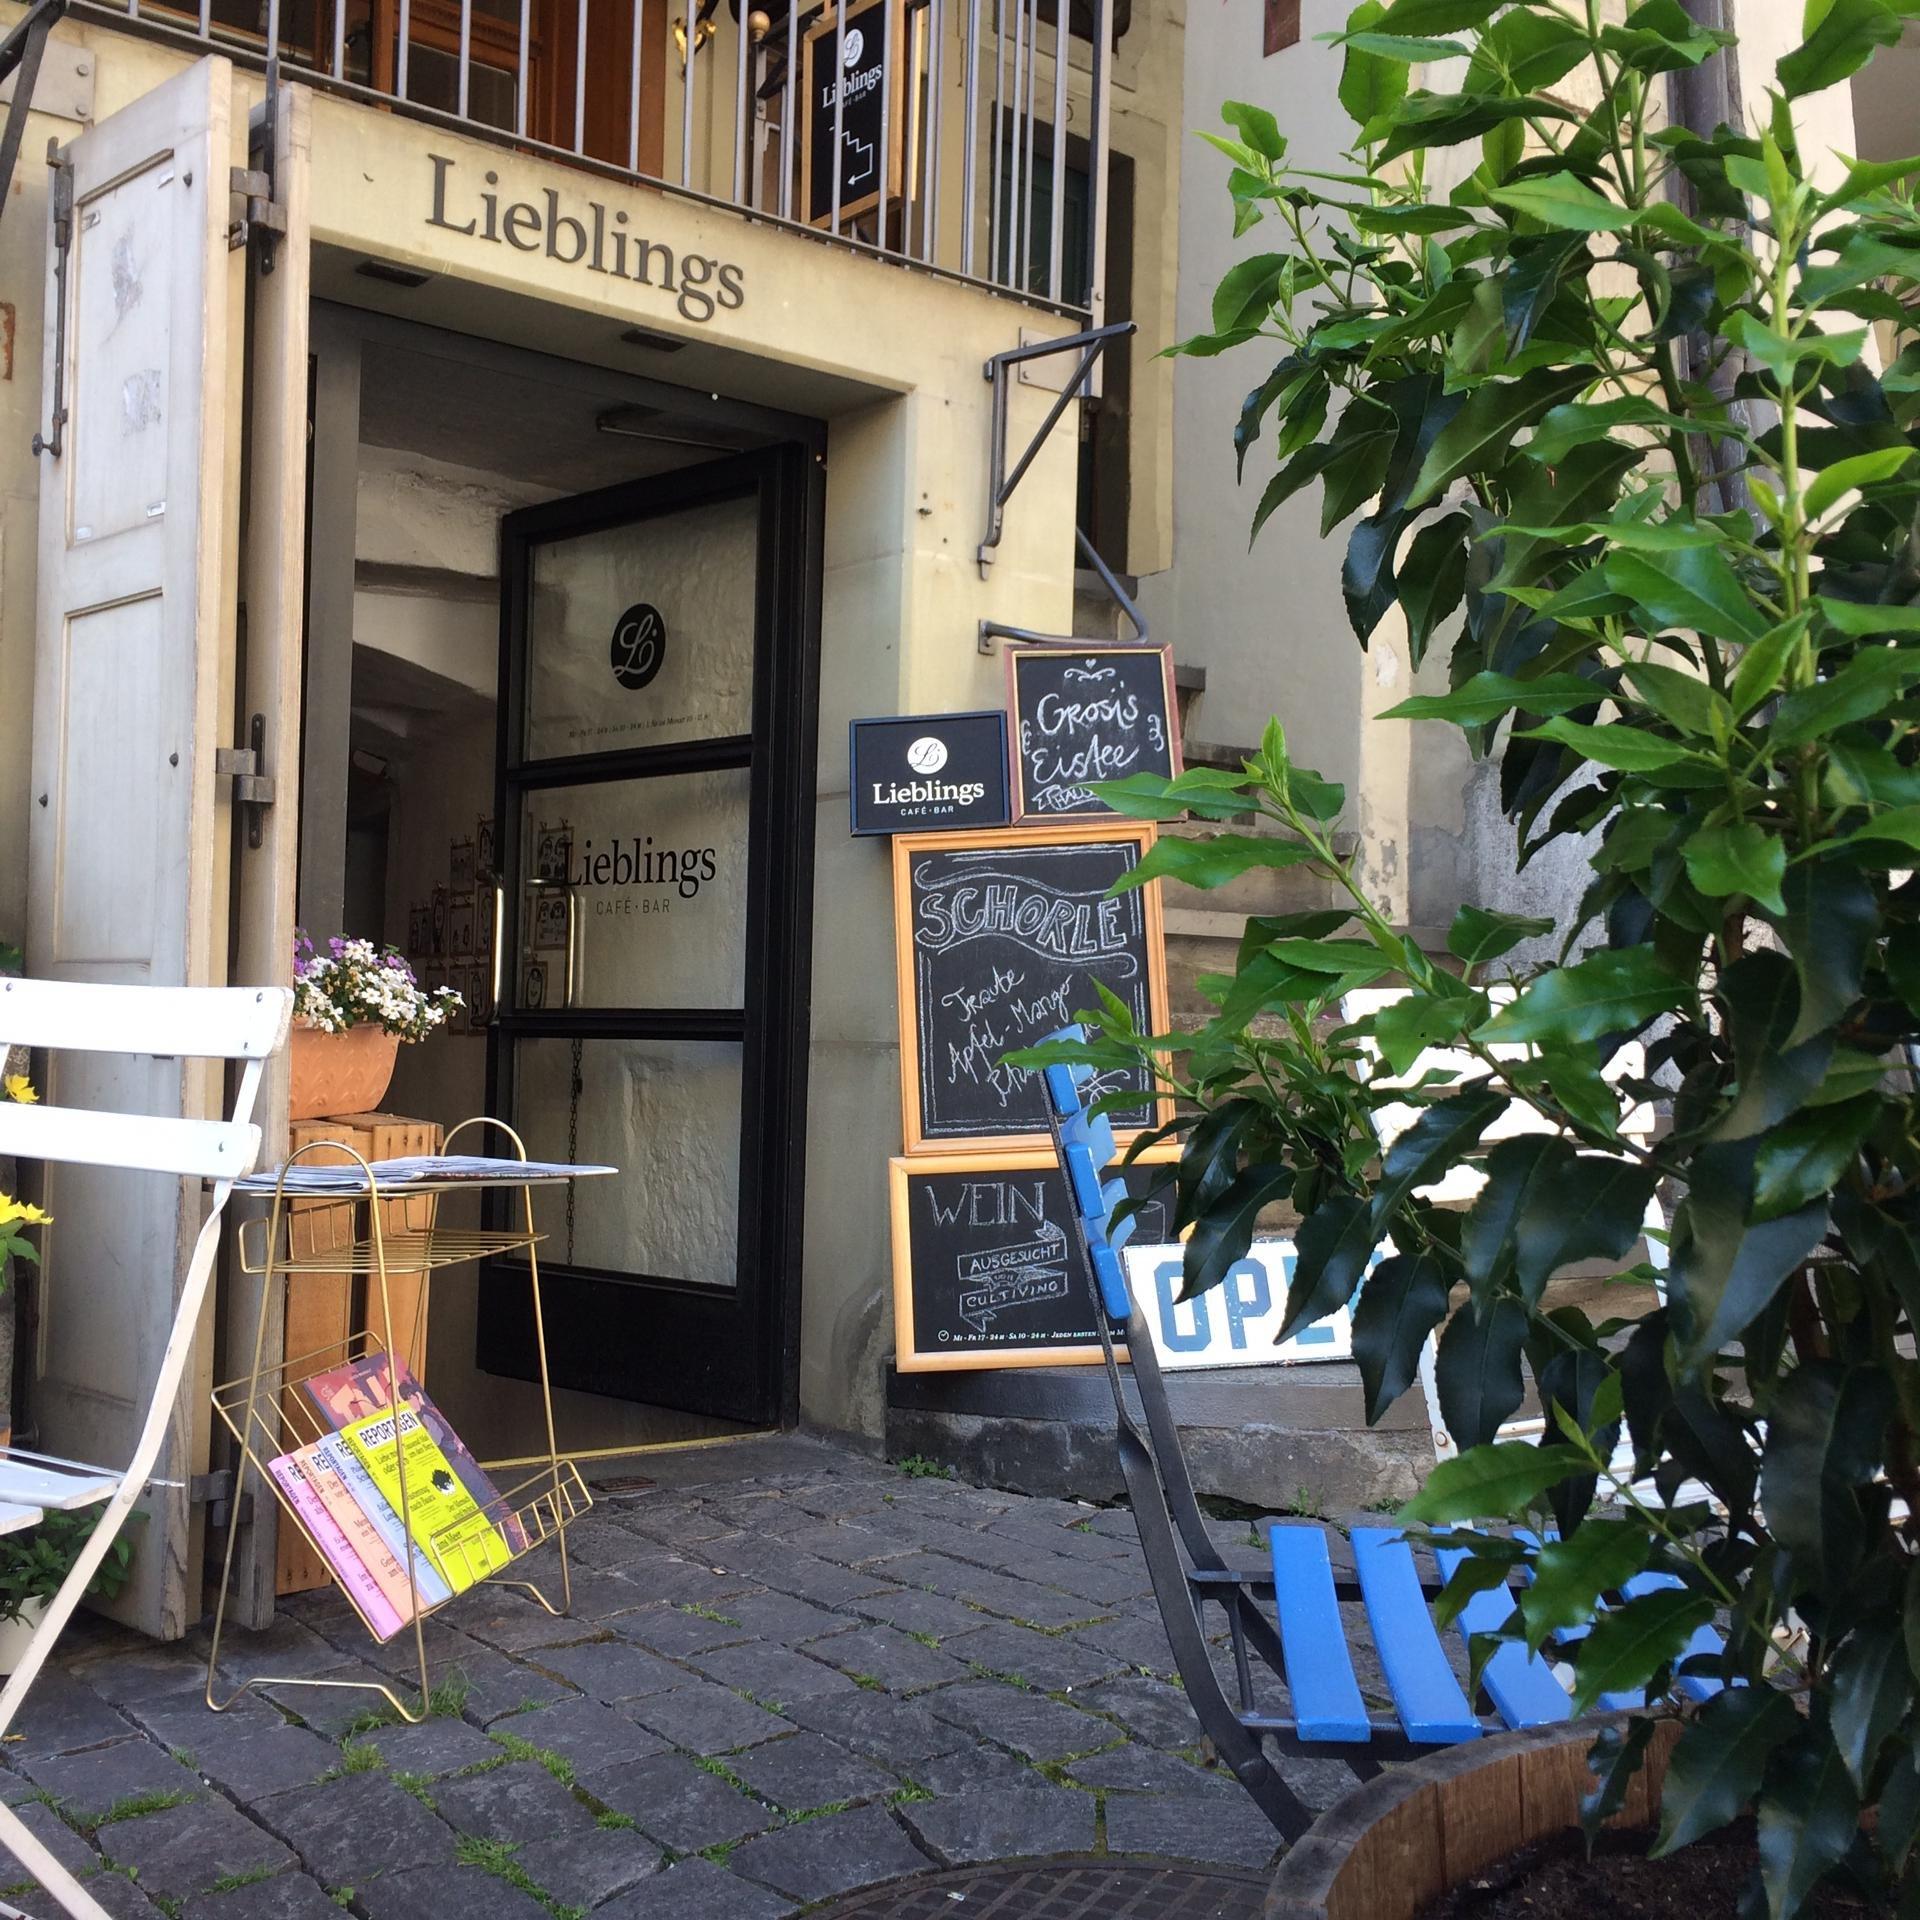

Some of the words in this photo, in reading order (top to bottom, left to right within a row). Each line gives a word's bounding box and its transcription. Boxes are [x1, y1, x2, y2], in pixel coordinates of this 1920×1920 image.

[822, 63, 882, 109] Liblings
[425, 153, 744, 322] Lieblings
[873, 780, 984, 806] Lieblings
[562, 836, 716, 899] Lieblings
[915, 884, 1127, 954] SCHORLE
[941, 966, 1025, 1022] Traube
[924, 1181, 1046, 1228] WEIN
[970, 1243, 1061, 1274] AUSGESUCHT
[966, 1281, 1058, 1308] CULTIVINO
[274, 1469, 301, 1505] REPORTAGEN
